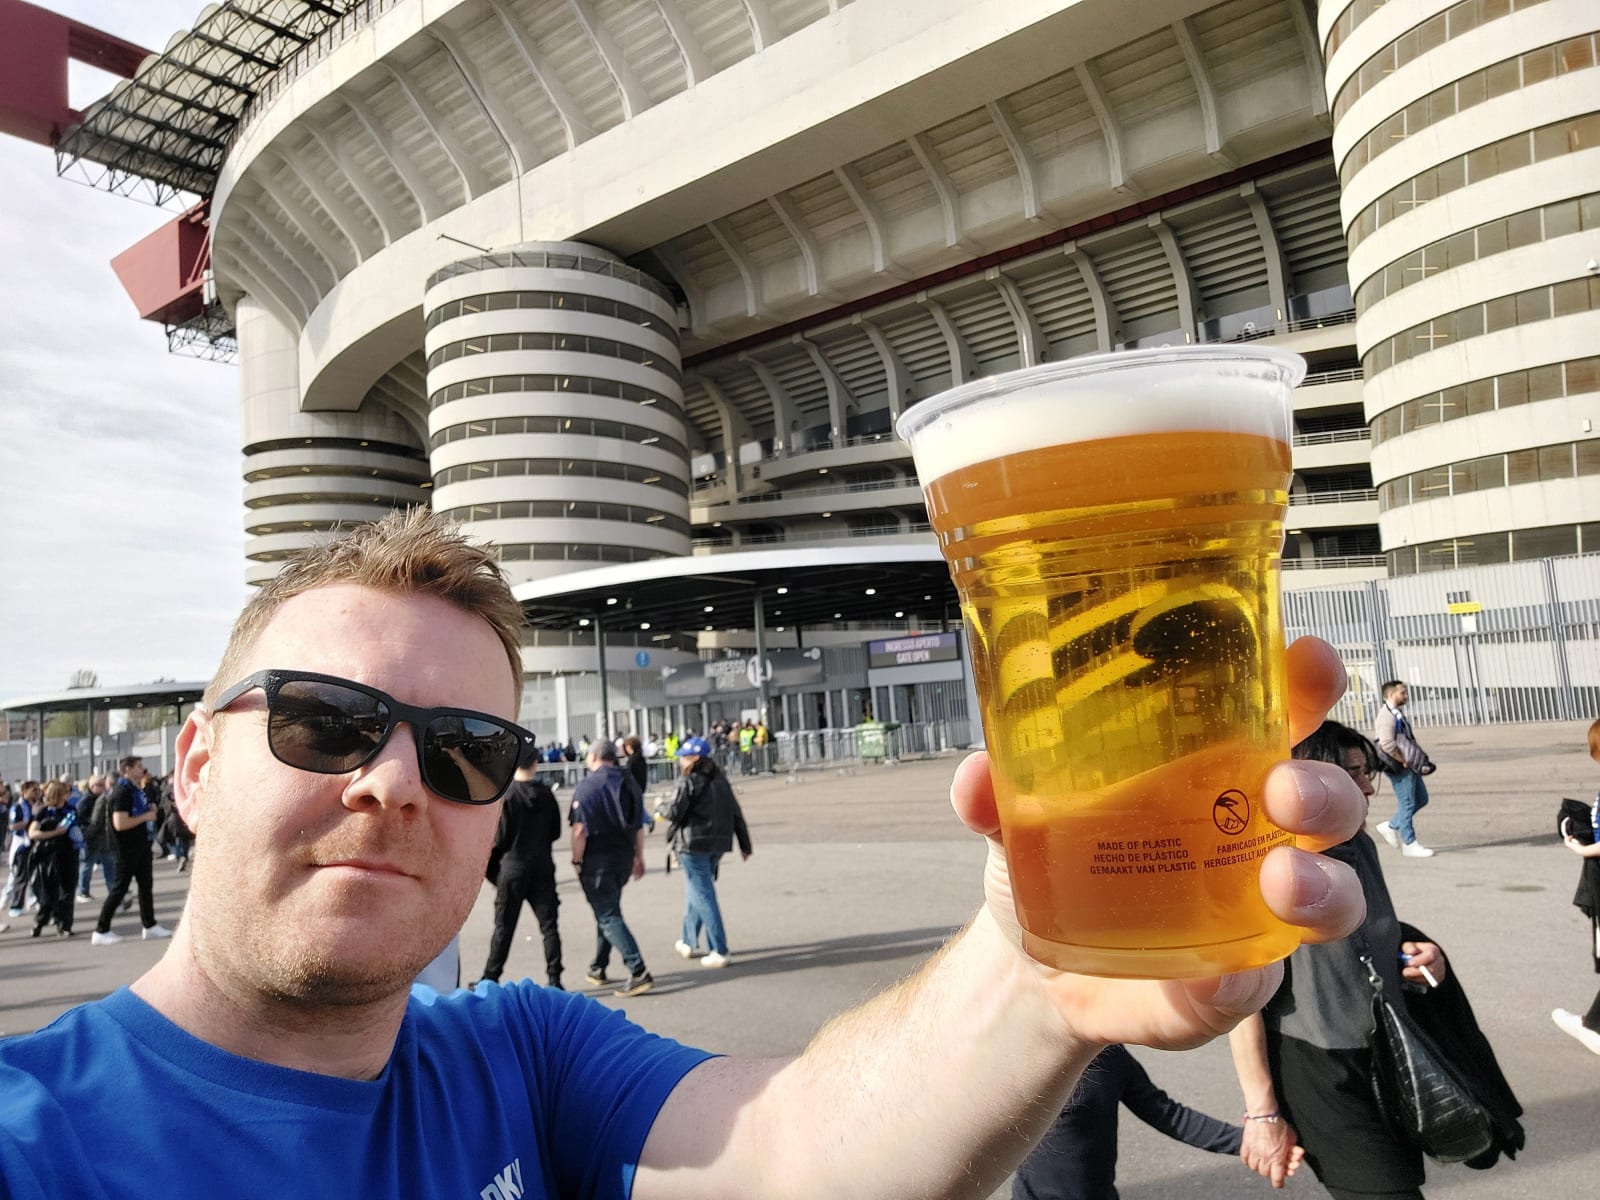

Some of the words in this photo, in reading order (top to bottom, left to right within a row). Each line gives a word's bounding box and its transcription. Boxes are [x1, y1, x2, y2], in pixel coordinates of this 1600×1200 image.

[885, 639, 914, 653] INGRESSO
[896, 652, 912, 664] GATE
[913, 650, 930, 662] OPEN
[704, 659, 746, 678] INGRESSO
[717, 674, 735, 688] GATE
[1097, 842, 1124, 851] MADE
[1127, 841, 1140, 850] OF
[1142, 838, 1182, 849] PLASTIC
[1217, 838, 1257, 855] FABRICADO
[1257, 836, 1266, 846] EM
[1094, 853, 1126, 863] HECHO
[1128, 853, 1141, 862] DE
[1143, 849, 1189, 862] PLÁSTICO
[1203, 852, 1255, 869] HERGESTELLT
[1256, 847, 1268, 858] AUS
[1090, 865, 1134, 875] GEMAAKT
[1136, 864, 1155, 874] VAN
[1158, 861, 1197, 873] PLASTIC
